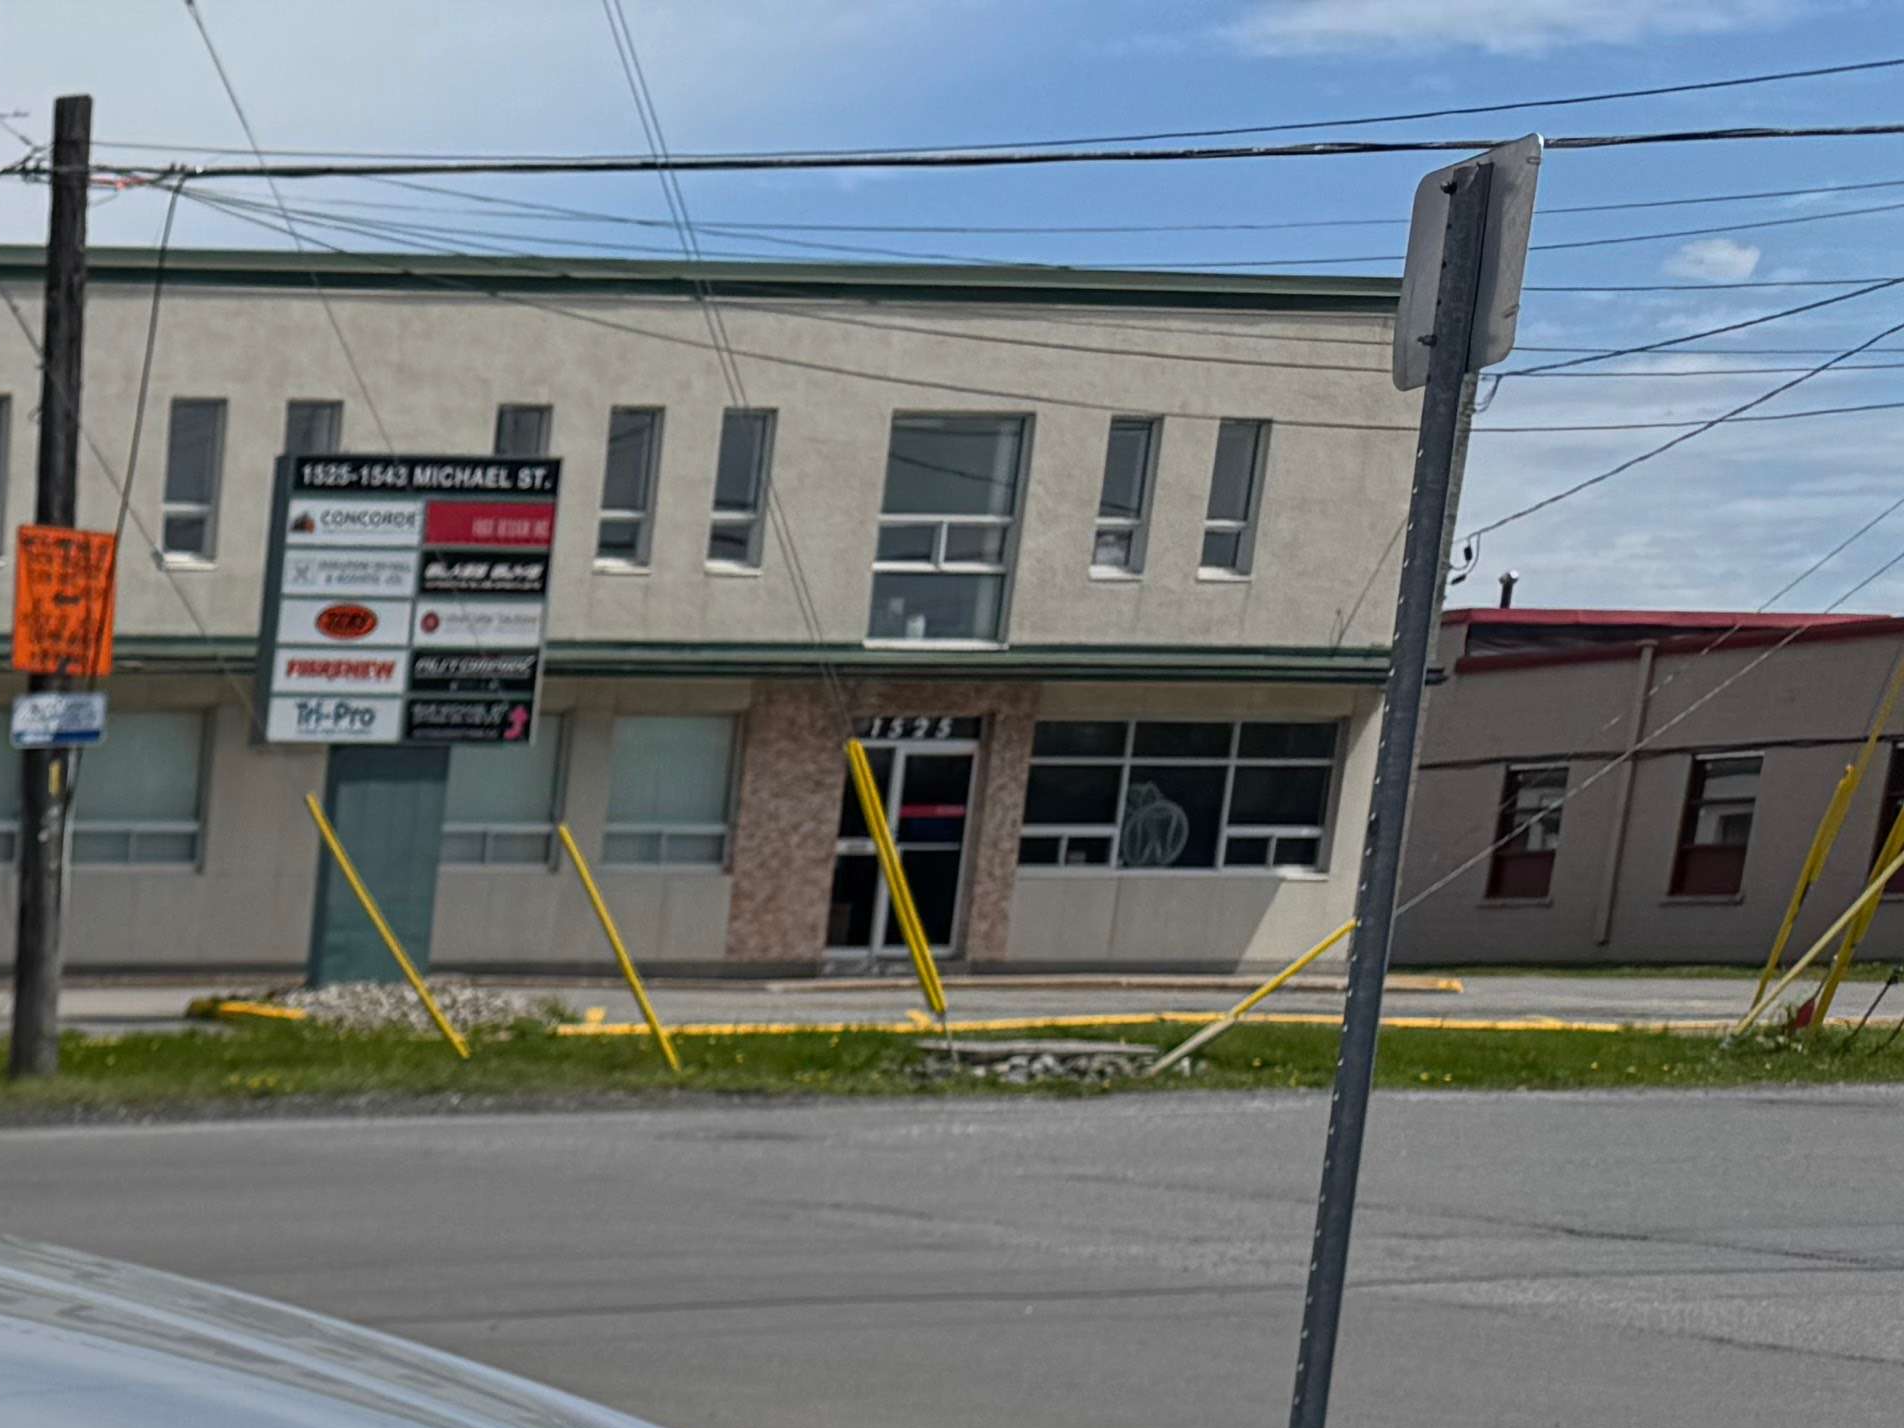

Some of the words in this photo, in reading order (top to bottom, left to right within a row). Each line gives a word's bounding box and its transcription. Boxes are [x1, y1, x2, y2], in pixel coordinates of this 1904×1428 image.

[302, 462, 408, 487] 1525-1543
[412, 463, 513, 488] MICHAEL
[516, 466, 552, 490] ST.
[294, 698, 376, 728] Tri-Pro
